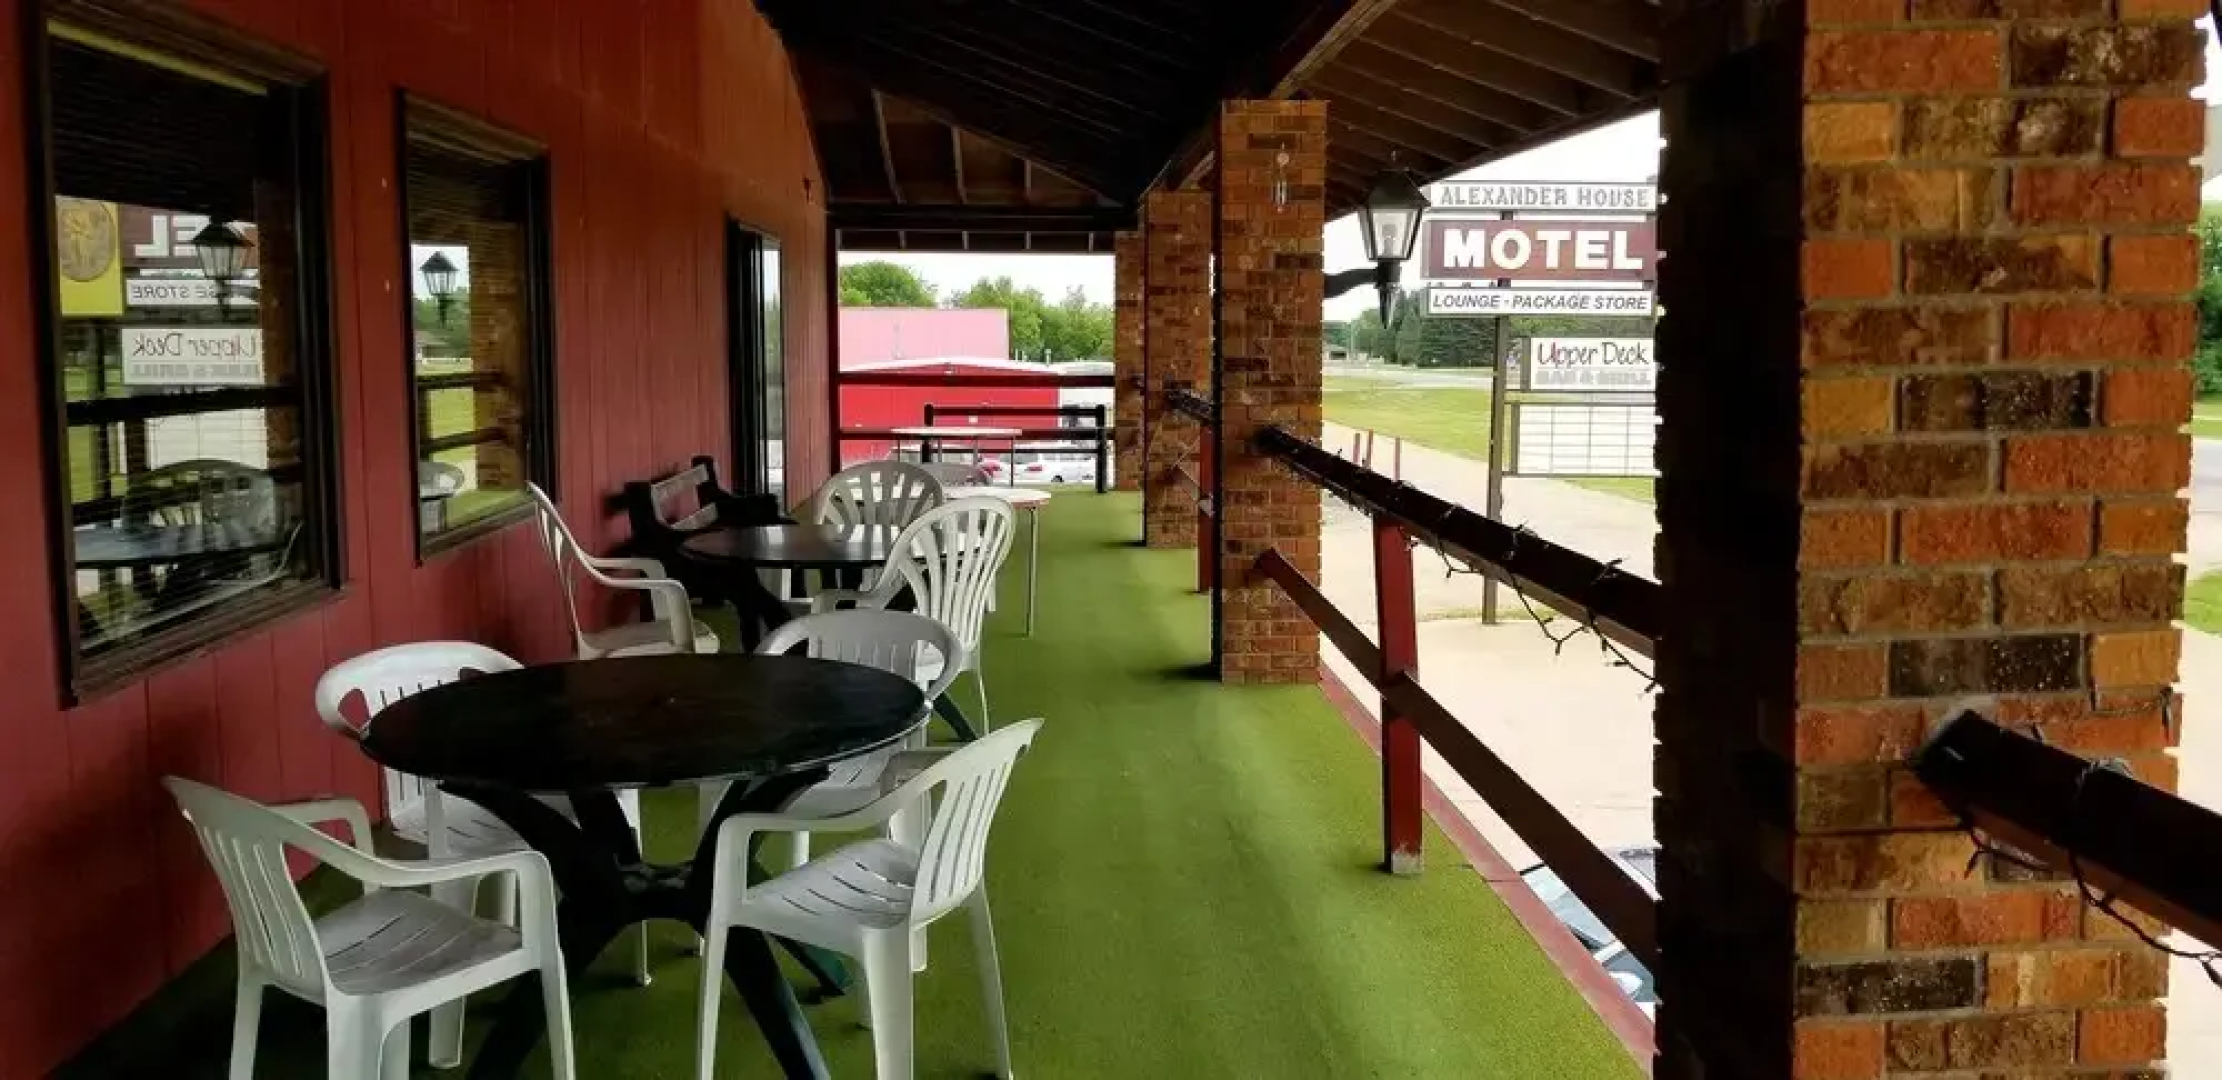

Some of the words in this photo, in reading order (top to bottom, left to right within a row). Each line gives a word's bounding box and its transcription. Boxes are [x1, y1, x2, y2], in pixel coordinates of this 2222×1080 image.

[1441, 186, 1567, 206] ALEXANDER
[1577, 188, 1650, 207] HOUSE
[1443, 228, 1643, 270] MOTEL
[1432, 294, 1501, 308] LOUNGE
[1512, 295, 1589, 309] PACKAGE
[1593, 295, 1648, 309] STORE
[1537, 341, 1598, 370] Upper
[1601, 341, 1650, 365] Deck
